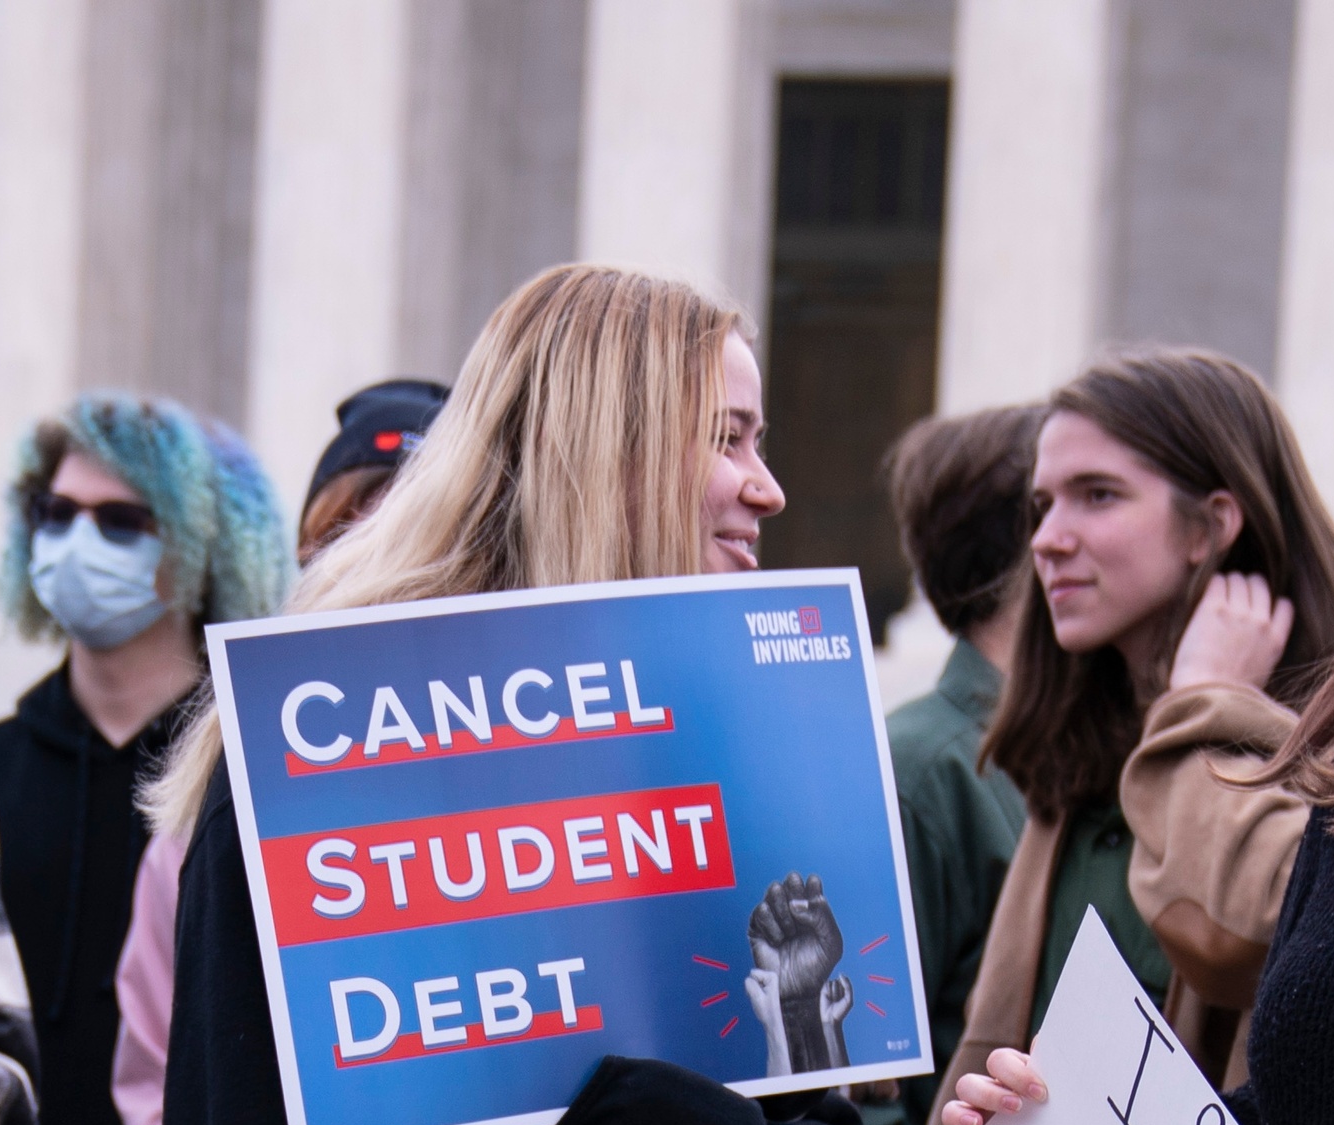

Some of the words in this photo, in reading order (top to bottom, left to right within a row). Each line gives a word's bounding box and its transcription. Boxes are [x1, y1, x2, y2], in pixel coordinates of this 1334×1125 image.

[745, 608, 800, 637] YOUNG
[752, 635, 852, 665] INVINCIBLES
[280, 659, 666, 764] CANCEL
[305, 804, 714, 919] STUDENT
[329, 958, 586, 1062] DEBT
